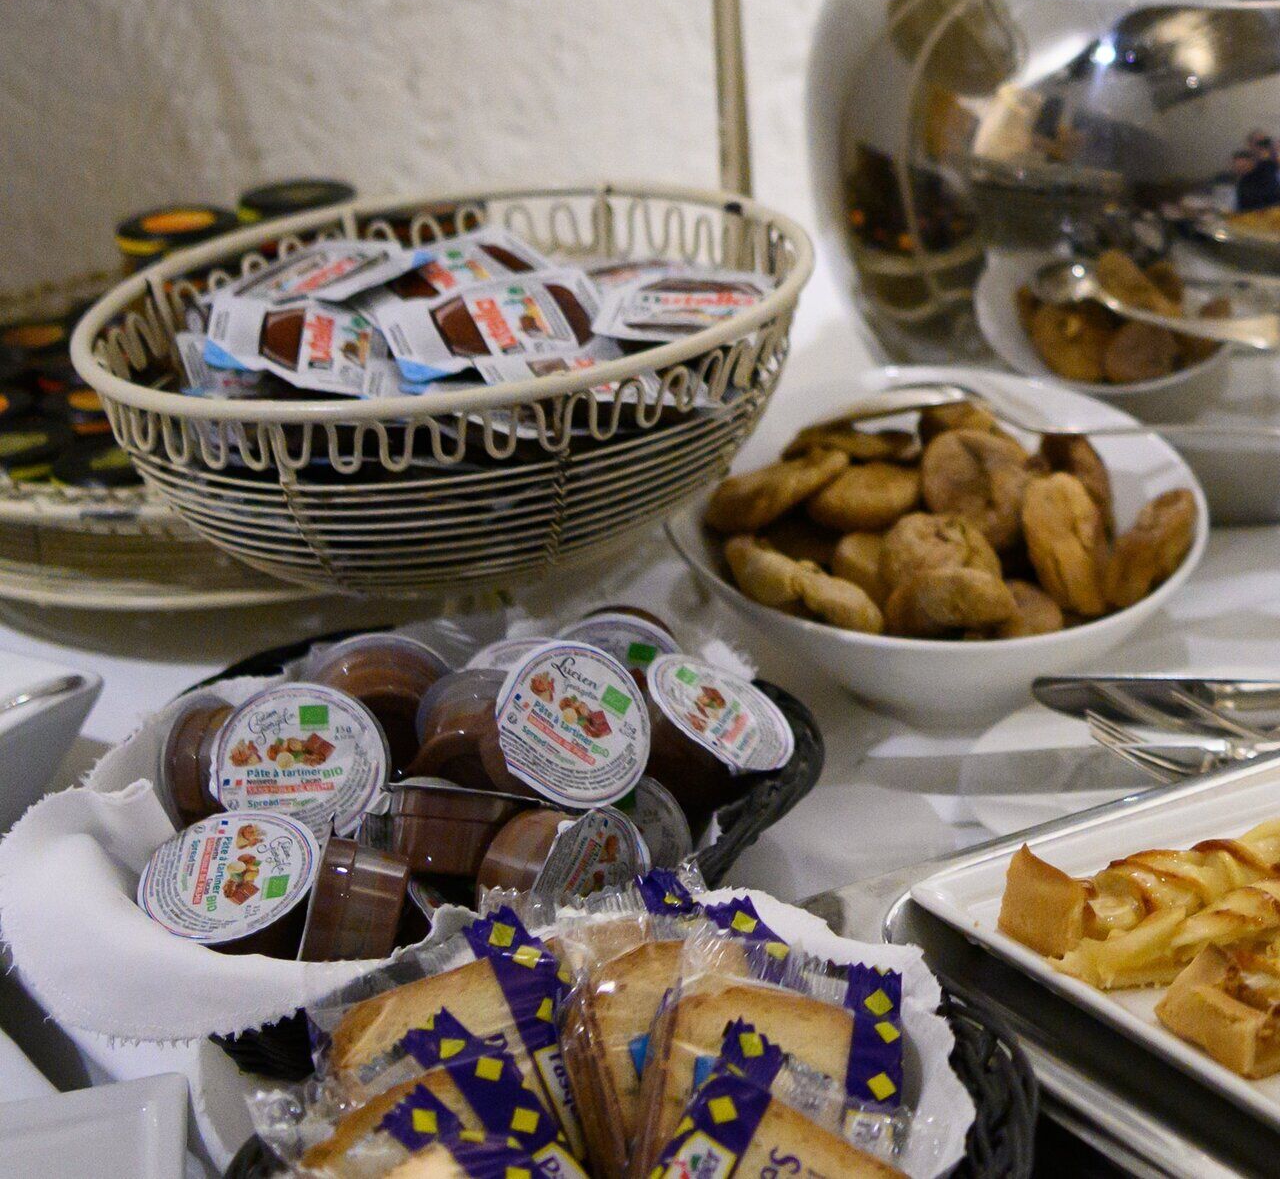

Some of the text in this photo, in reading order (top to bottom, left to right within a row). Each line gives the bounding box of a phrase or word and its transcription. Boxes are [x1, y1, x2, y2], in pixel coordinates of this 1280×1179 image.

[247, 768, 274, 779] Pâte
[281, 767, 321, 778] tartiner
[321, 766, 344, 780] BIO
[247, 797, 280, 811] Spread
[221, 835, 234, 856] Pâte
[213, 862, 227, 896] tartiner
[205, 895, 218, 913] BIO
